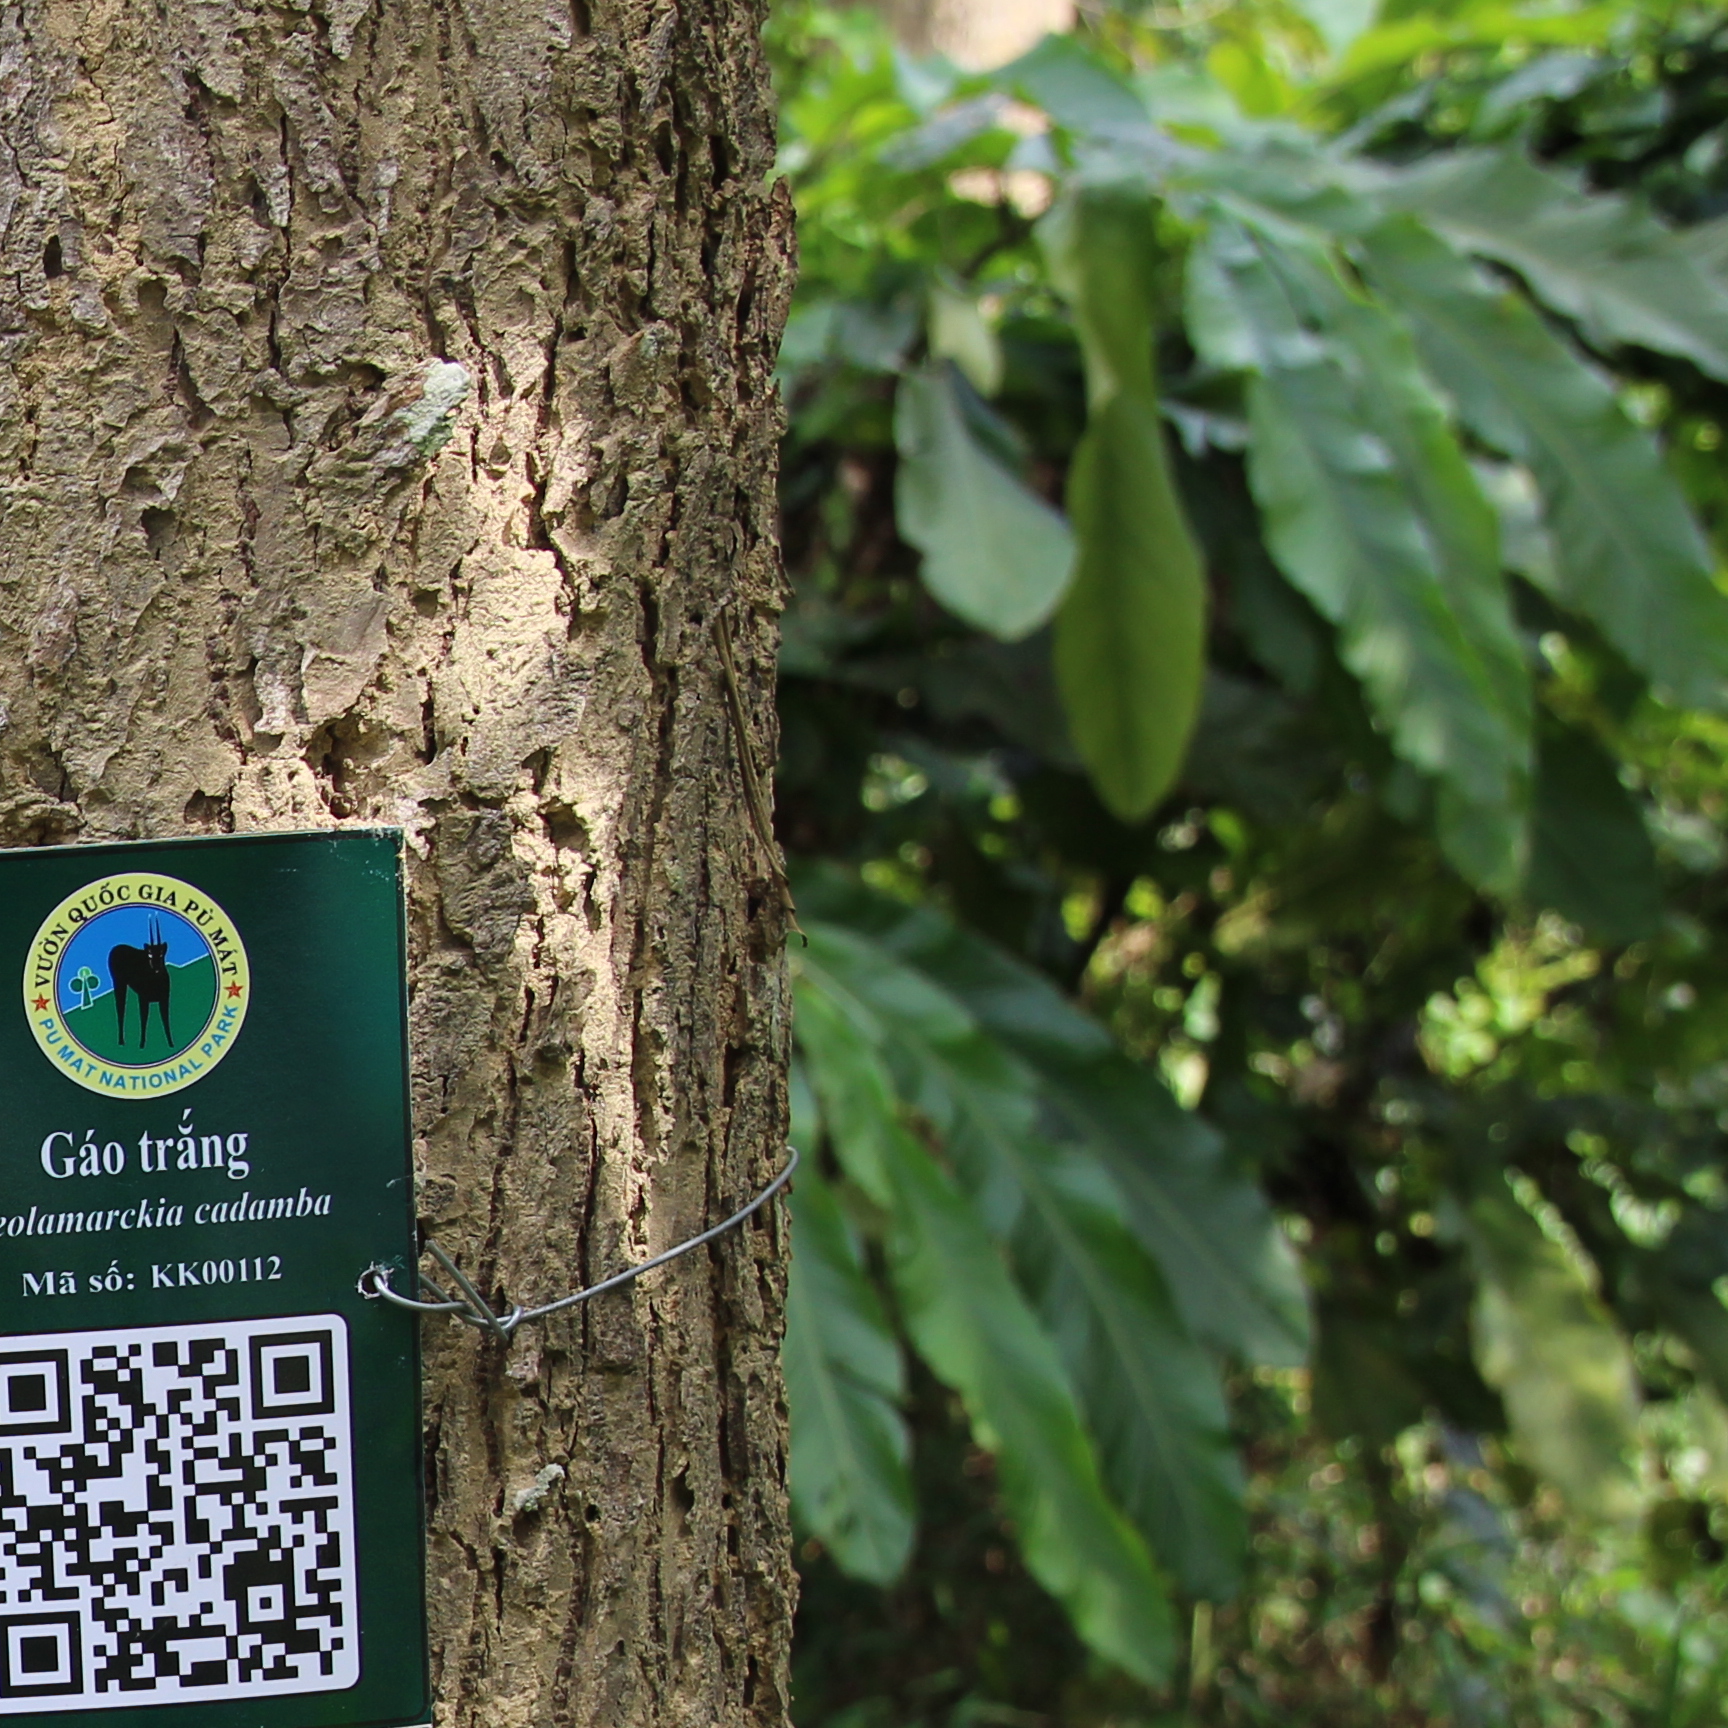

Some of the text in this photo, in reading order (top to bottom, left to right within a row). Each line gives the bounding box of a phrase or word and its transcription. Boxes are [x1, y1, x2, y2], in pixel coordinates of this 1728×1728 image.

[34, 923, 70, 989] VƯỜN
[68, 882, 131, 925] QUỐC
[138, 884, 178, 907] GIA
[38, 1003, 239, 1090] PU MAT NATIONAL PARK
[40, 1108, 250, 1180] Gáo trắng
[194, 1187, 332, 1226] cadamba
[22, 1255, 284, 1297] Mã số: KK00112
